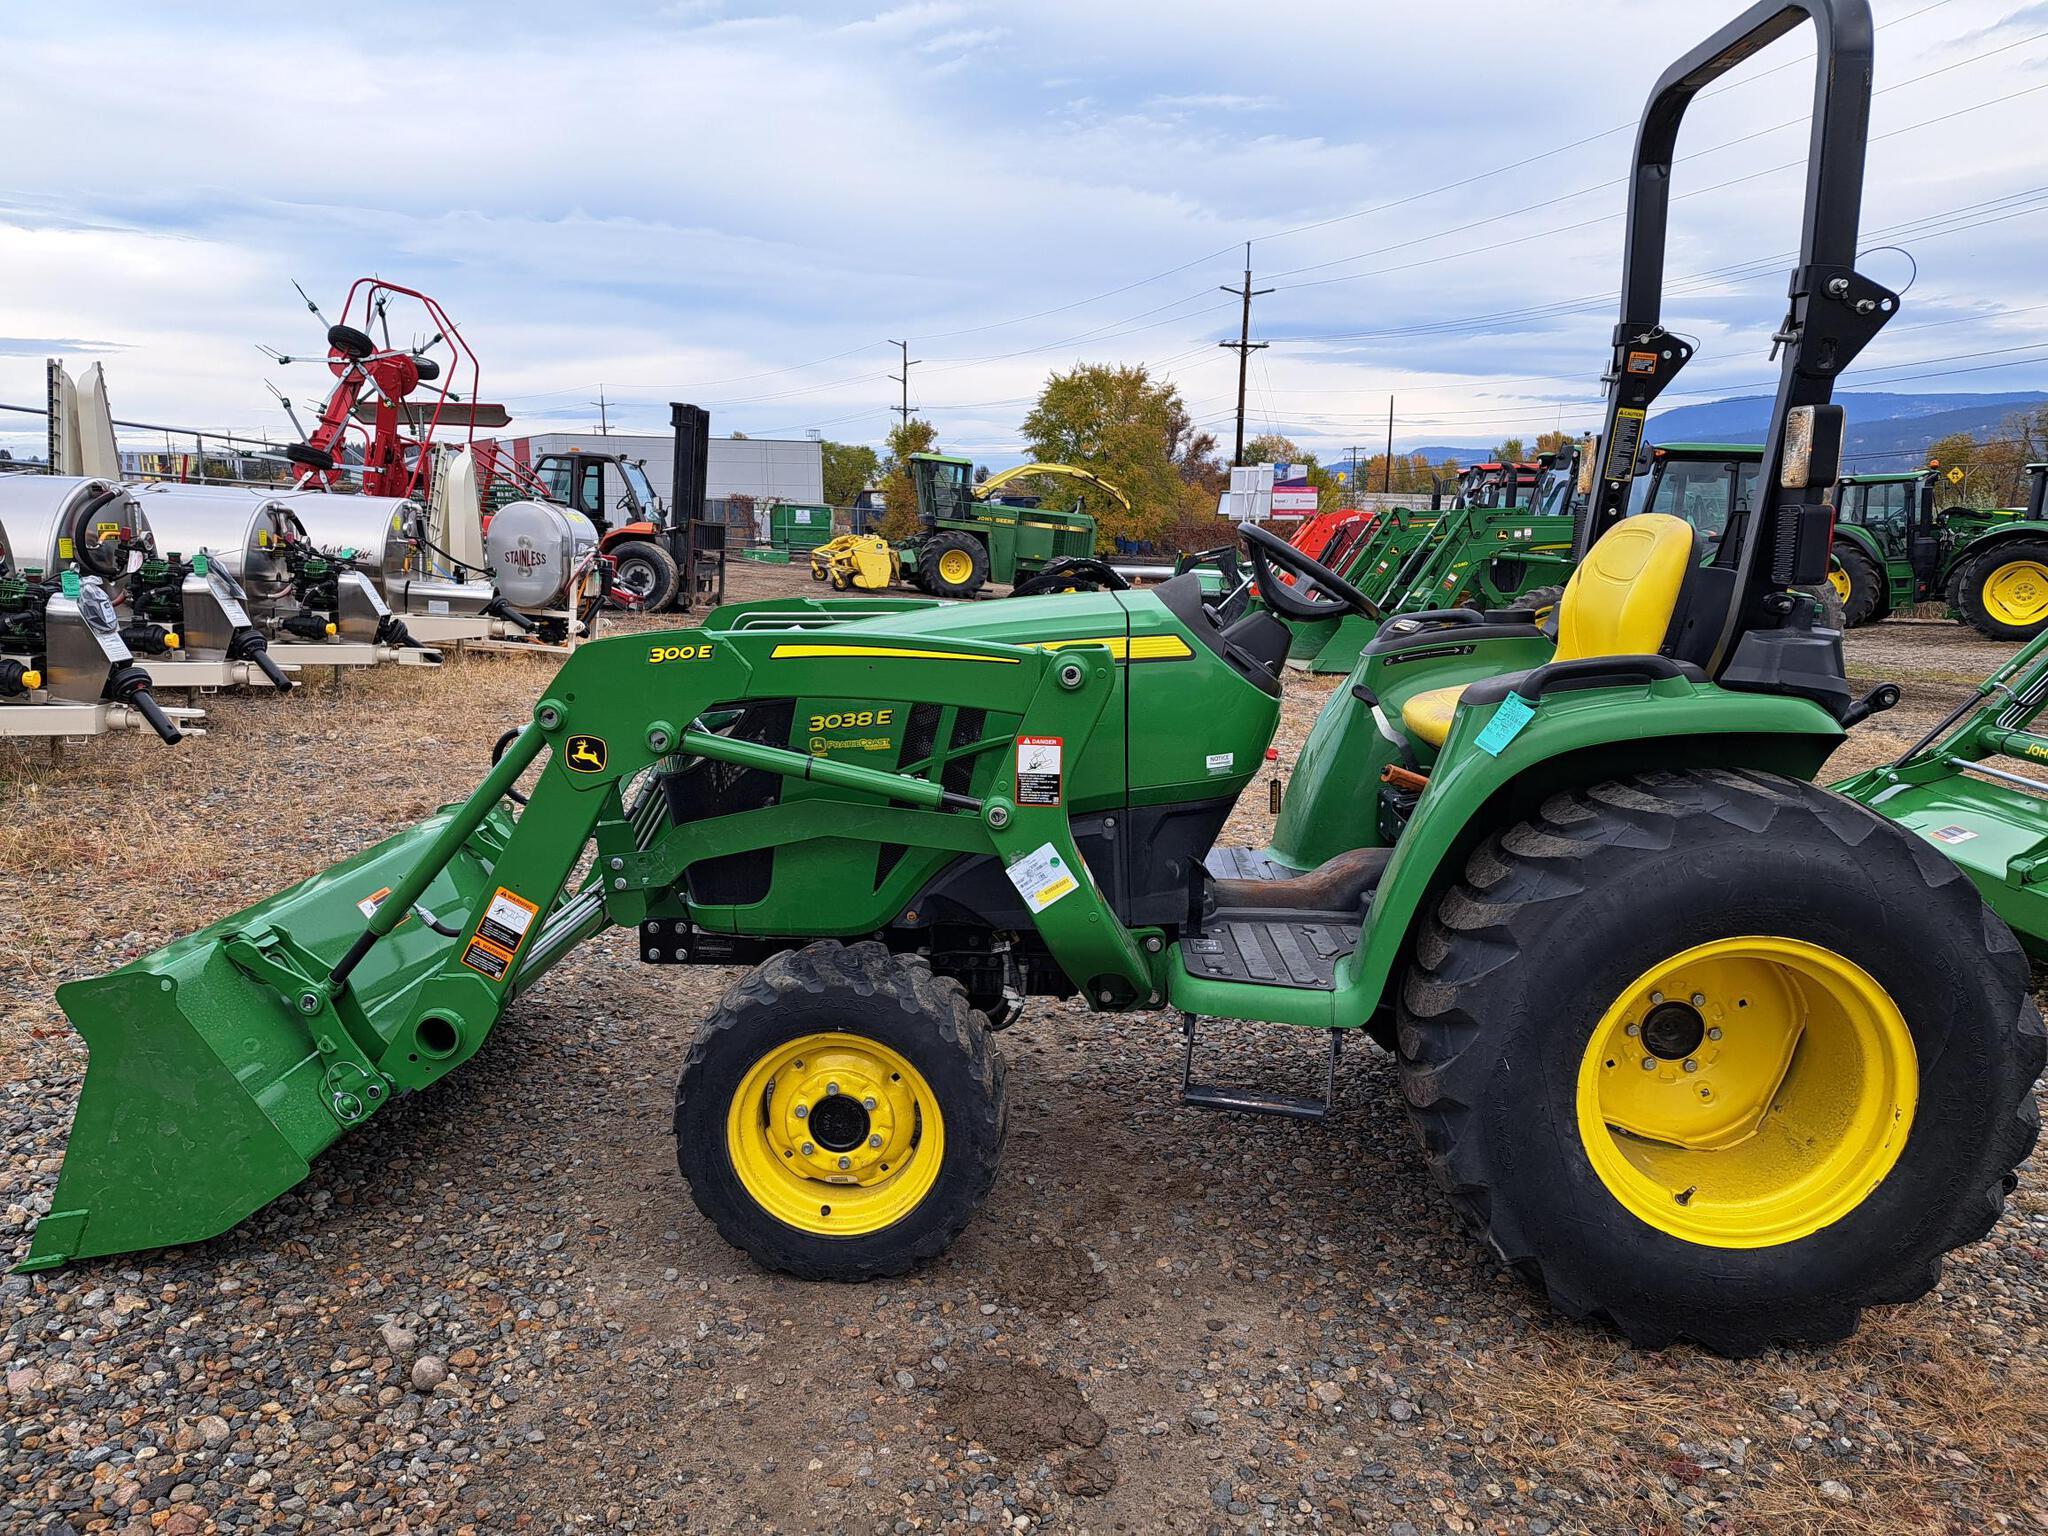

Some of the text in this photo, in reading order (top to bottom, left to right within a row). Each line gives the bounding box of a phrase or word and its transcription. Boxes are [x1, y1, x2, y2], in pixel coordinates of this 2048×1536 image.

[995, 516, 1016, 525] DEERE
[504, 549, 547, 567] STAINLESS
[648, 644, 714, 664] 300 E
[808, 708, 894, 732] 3038 E
[1210, 754, 1229, 762] NOTICE
[2025, 743, 2048, 759] JOH
[508, 894, 533, 911] WARNING
[482, 942, 508, 960] WARNING
